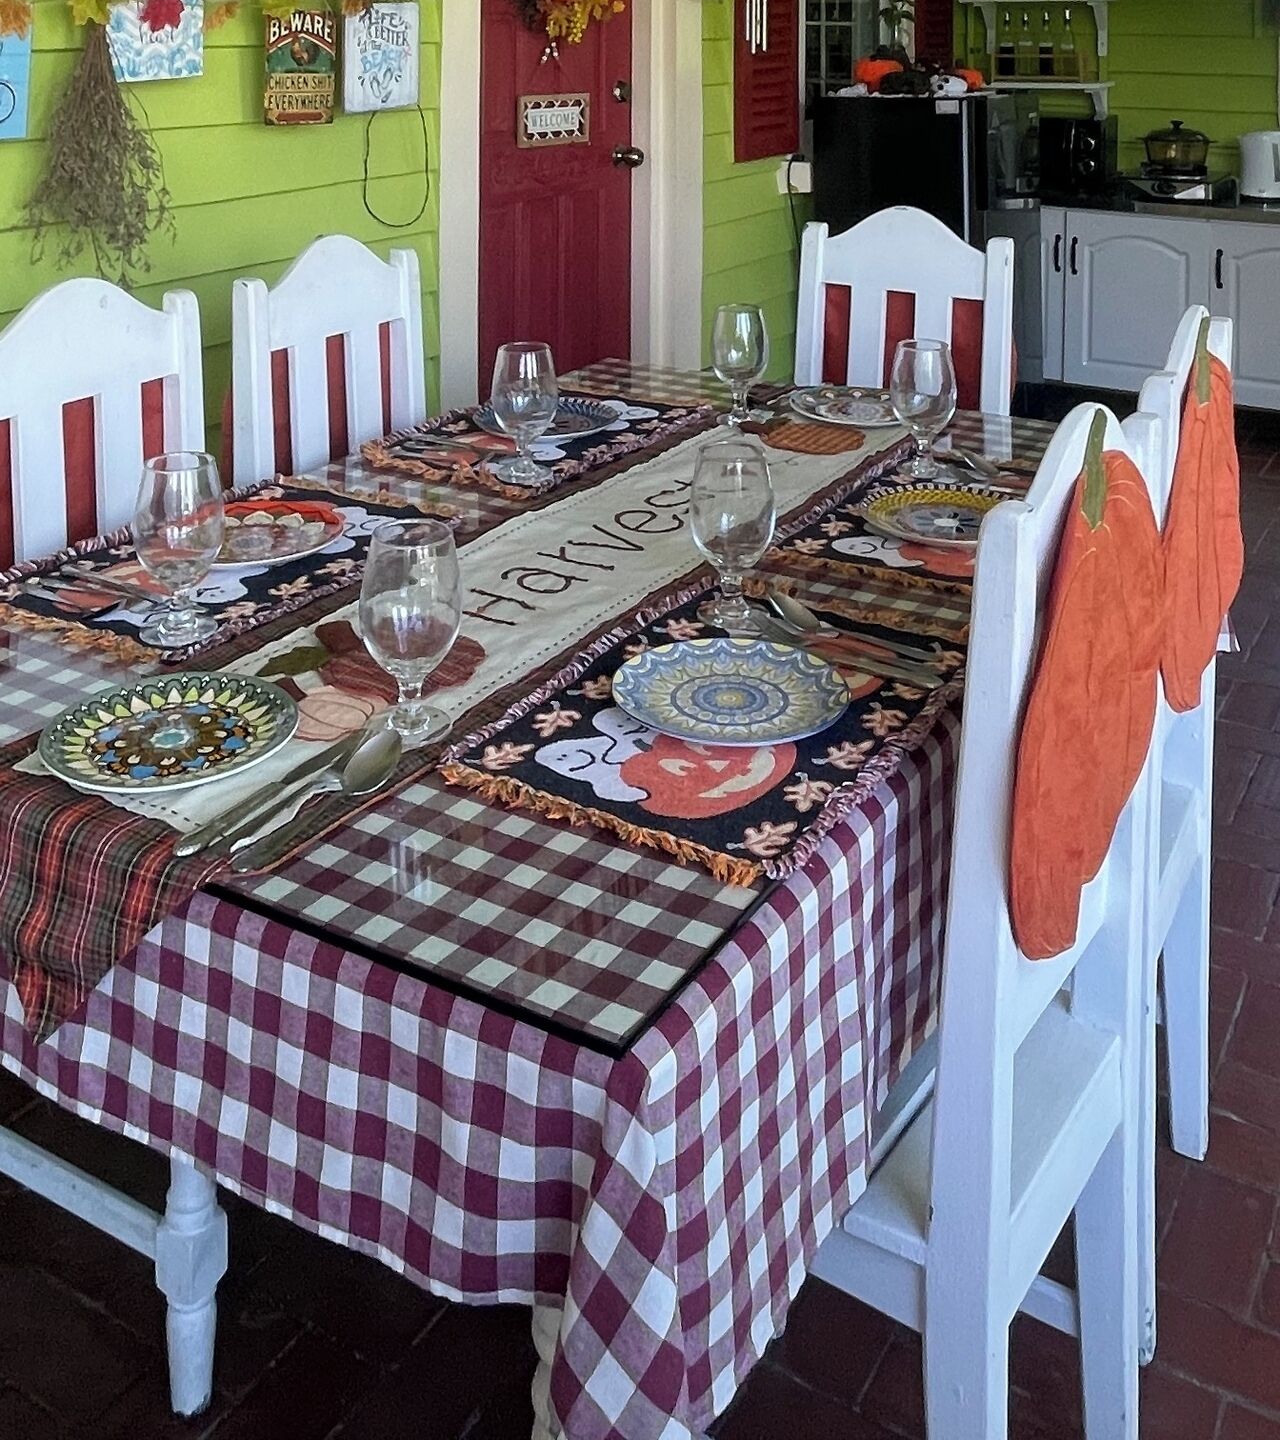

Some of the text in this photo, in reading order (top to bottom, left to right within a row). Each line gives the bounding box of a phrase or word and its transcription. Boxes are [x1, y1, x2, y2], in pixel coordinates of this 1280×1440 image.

[269, 13, 334, 44] BEWARE
[269, 76, 332, 90] CHICKEN SHIT
[268, 94, 331, 111] EVERYWHERE
[531, 112, 577, 128] WELCOME
